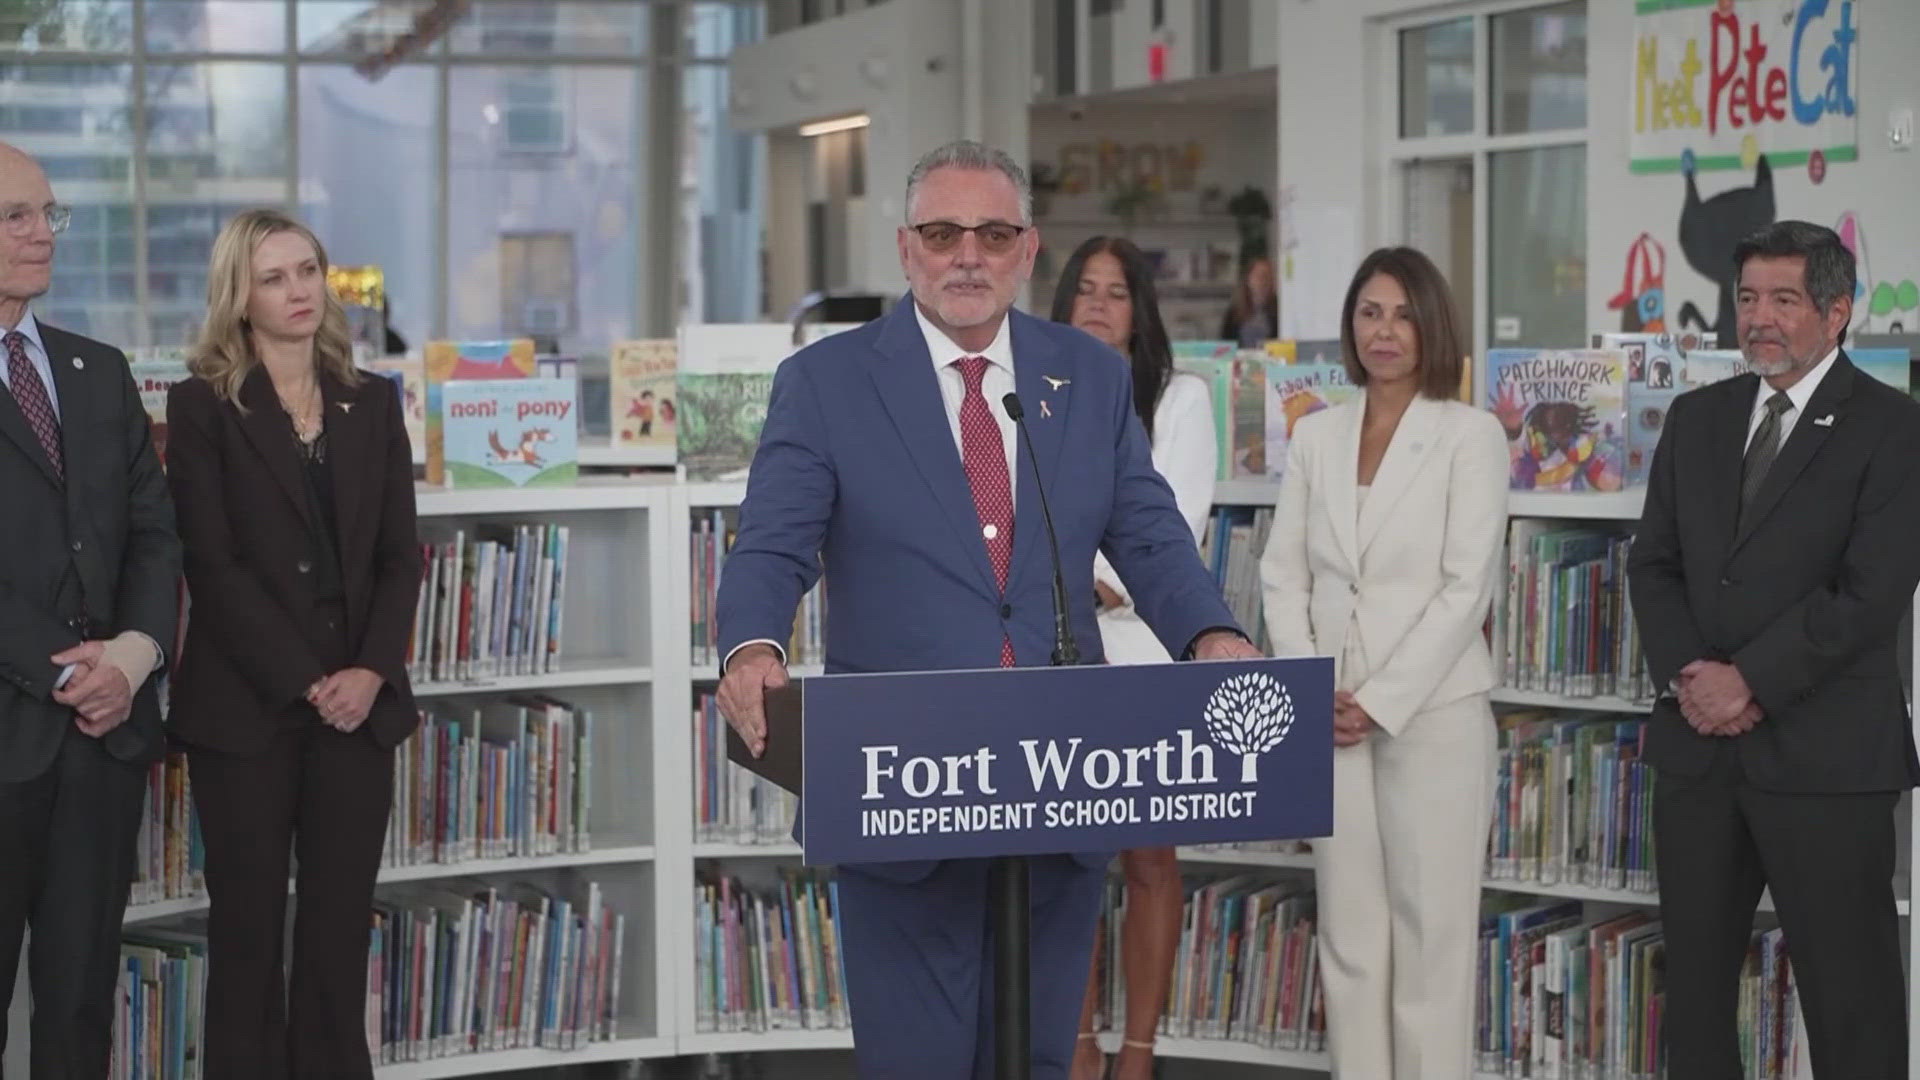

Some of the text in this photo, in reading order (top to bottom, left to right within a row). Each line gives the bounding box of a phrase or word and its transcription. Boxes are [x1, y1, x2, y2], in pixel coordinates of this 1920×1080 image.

[1636, 0, 1856, 136] Meet Pete Cat
[1498, 359, 1616, 386] PATCHWORK
[1520, 380, 1592, 402] PRINCE
[450, 399, 571, 421] noni pony
[862, 729, 1218, 800] Fort Worth
[862, 790, 1257, 837] INDEPENDENT SCHOOL DISTRICT
